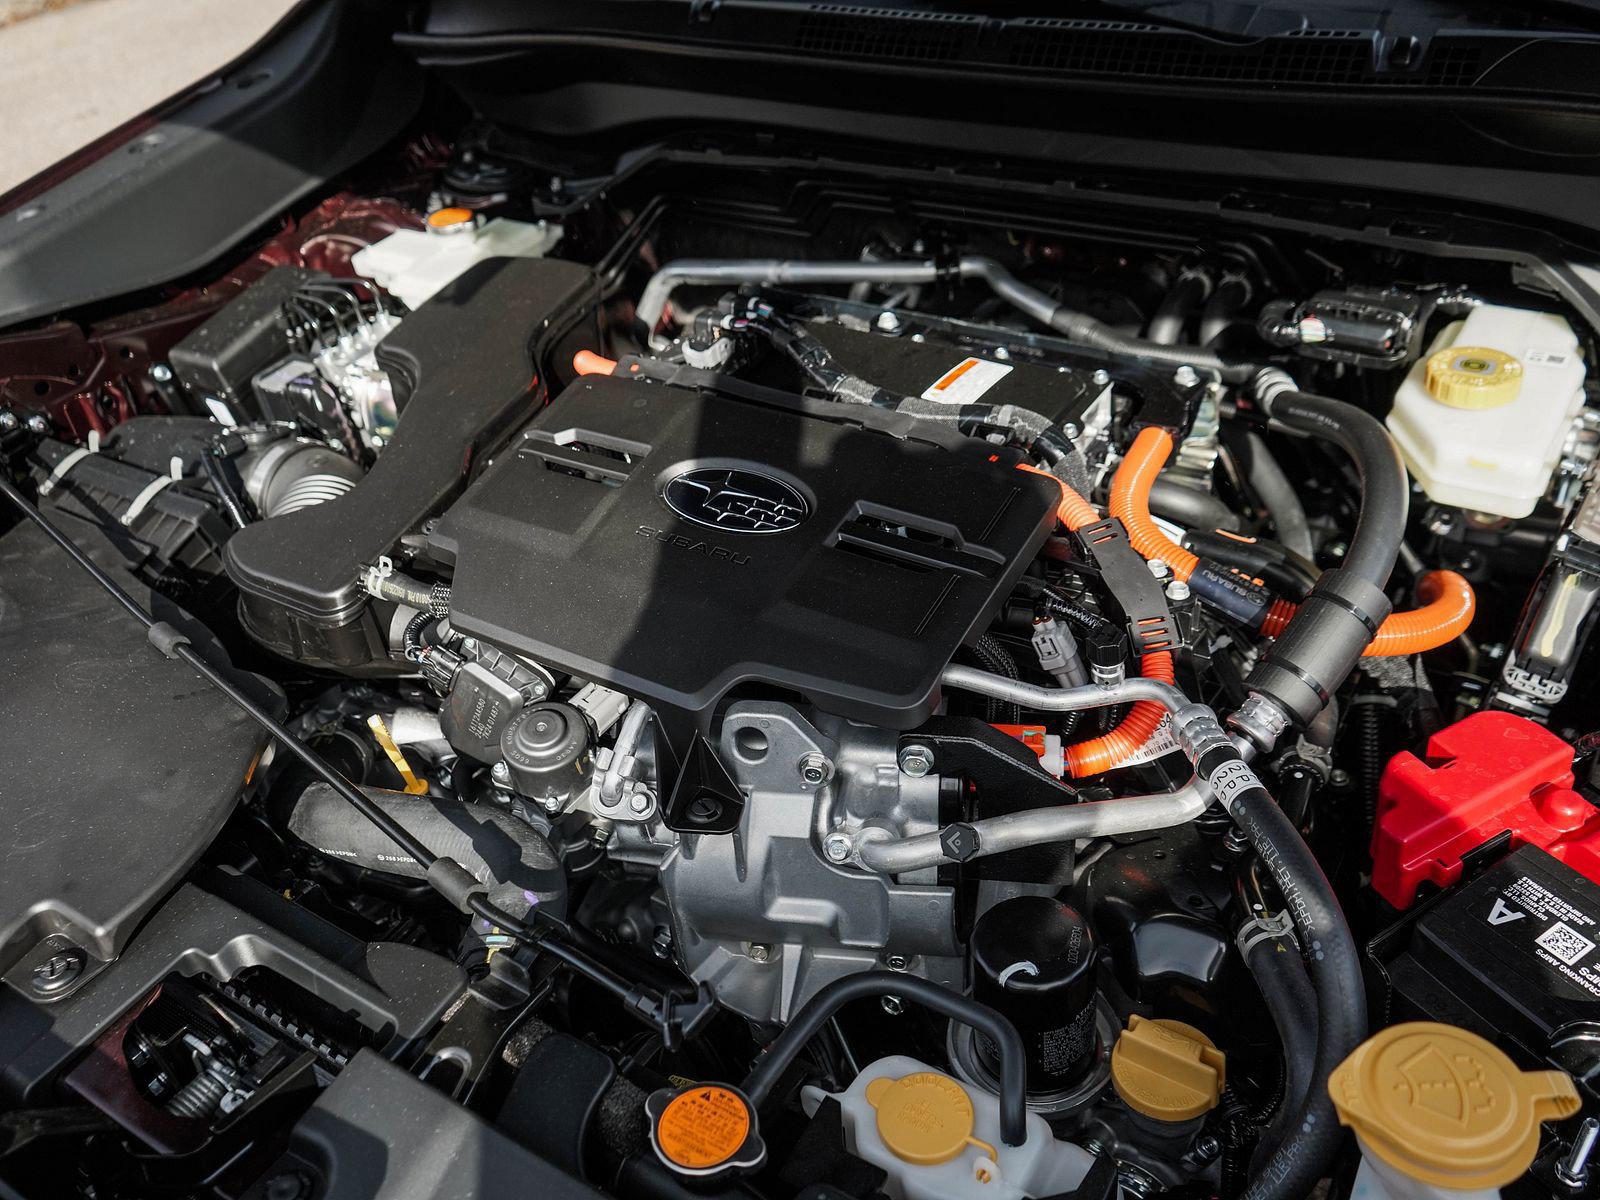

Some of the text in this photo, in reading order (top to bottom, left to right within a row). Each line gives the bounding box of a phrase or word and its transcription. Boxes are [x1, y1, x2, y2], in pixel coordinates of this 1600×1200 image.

[636, 525, 750, 565] SUBARU
[1202, 569, 1247, 596] SUBARU
[1522, 876, 1554, 899] MATERIALS
[1487, 898, 1526, 926] A
[1511, 895, 1548, 921] DISTRIBUTED
[1552, 896, 1583, 918] IMPORTED
[1535, 948, 1600, 997] CRANKING AMPS
